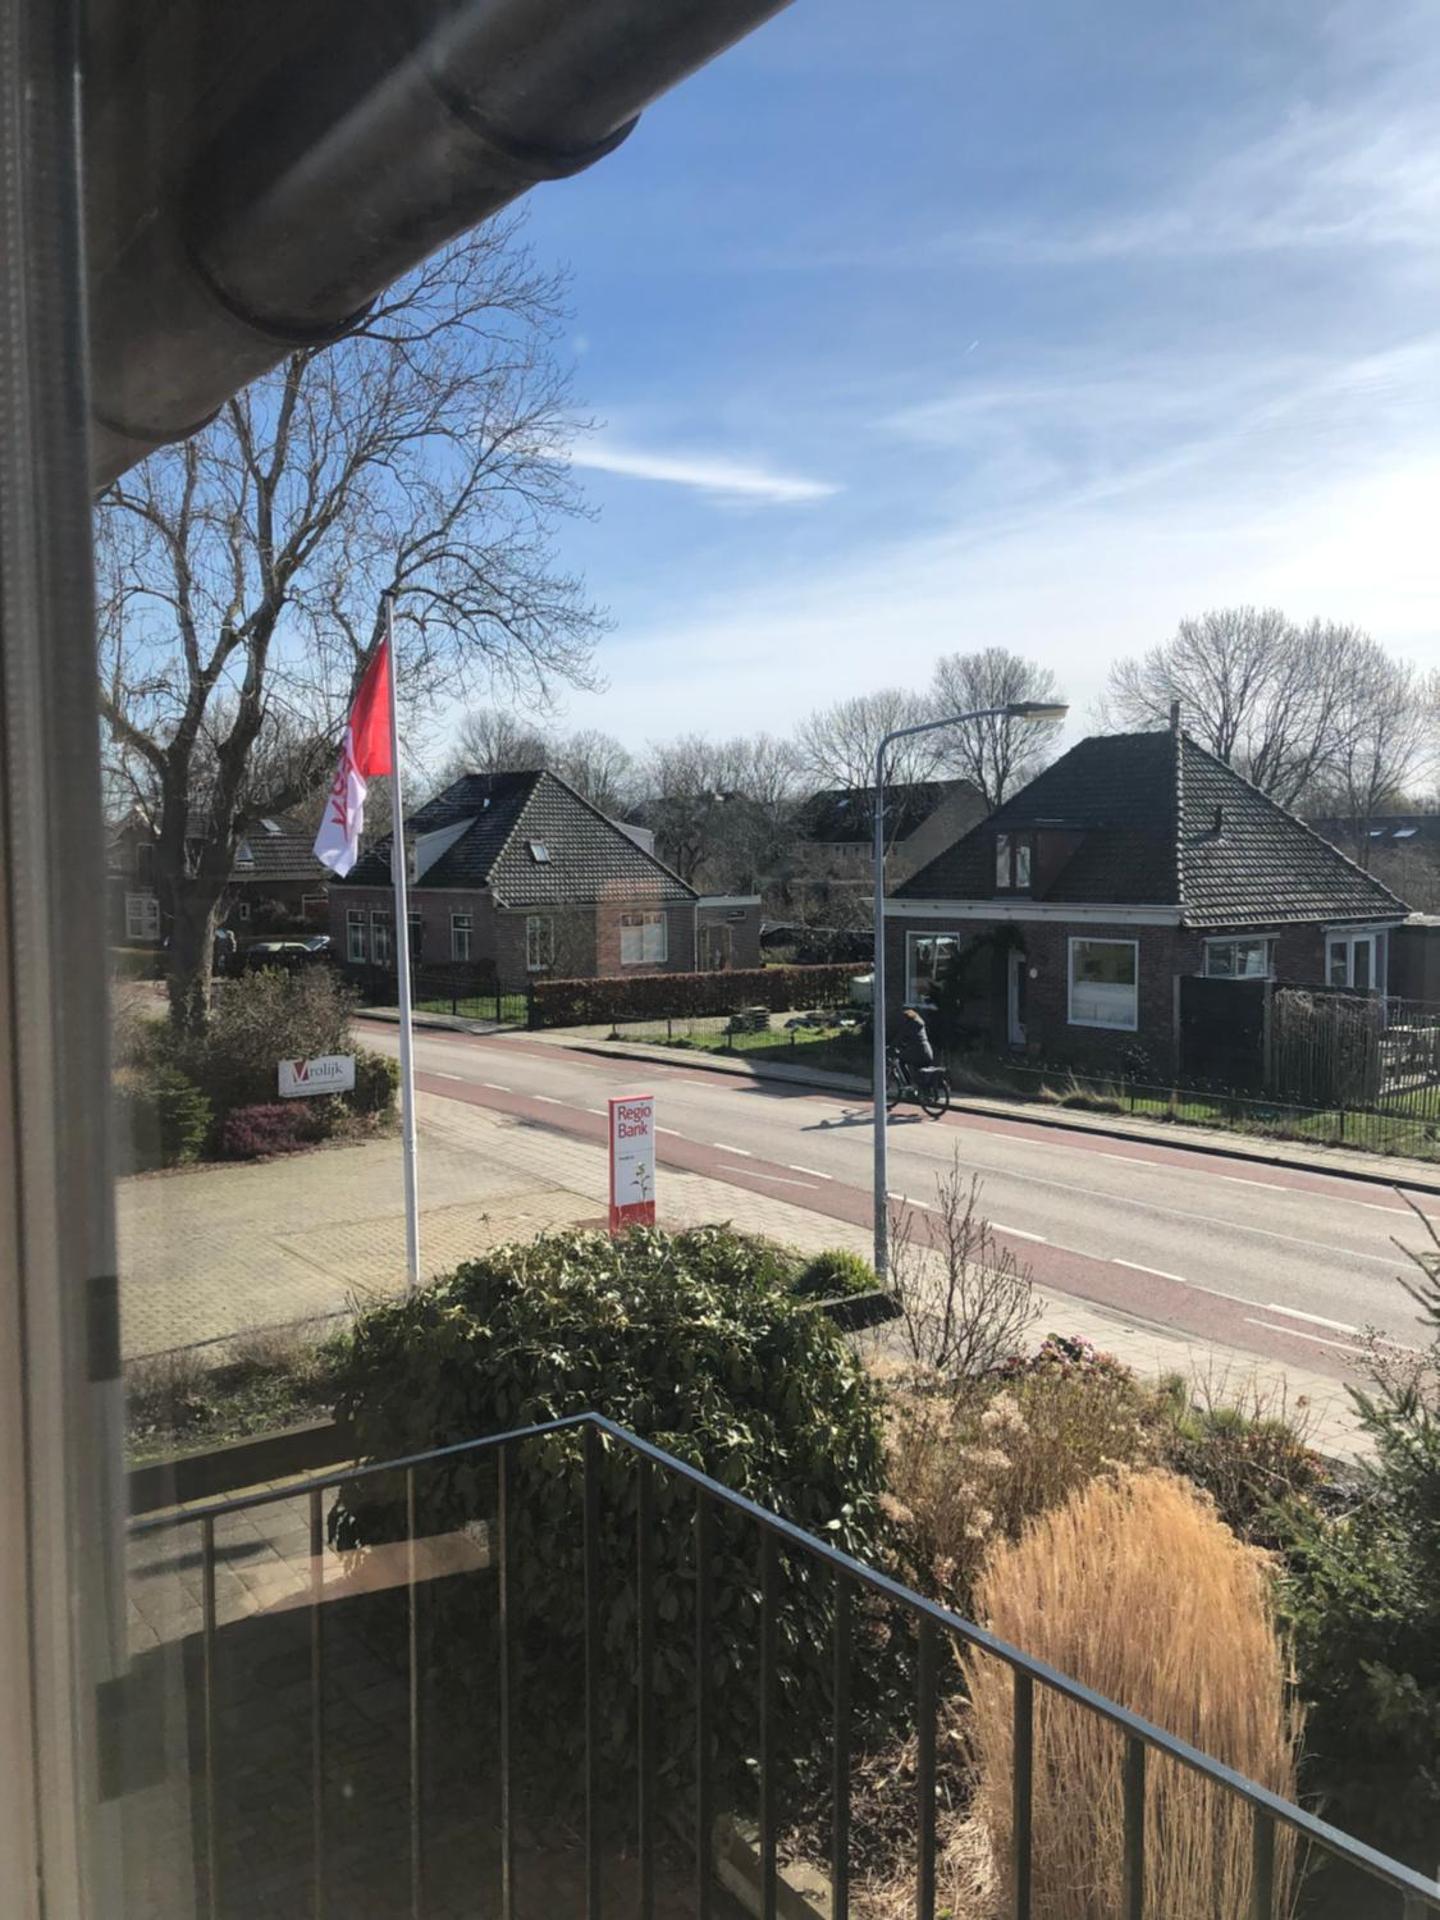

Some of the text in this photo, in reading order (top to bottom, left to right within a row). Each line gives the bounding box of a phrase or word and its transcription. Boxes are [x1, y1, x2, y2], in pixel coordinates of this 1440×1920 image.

[293, 1058, 343, 1081] Vrolijk
[617, 1102, 651, 1122] Regio
[618, 1121, 648, 1139] Bank
